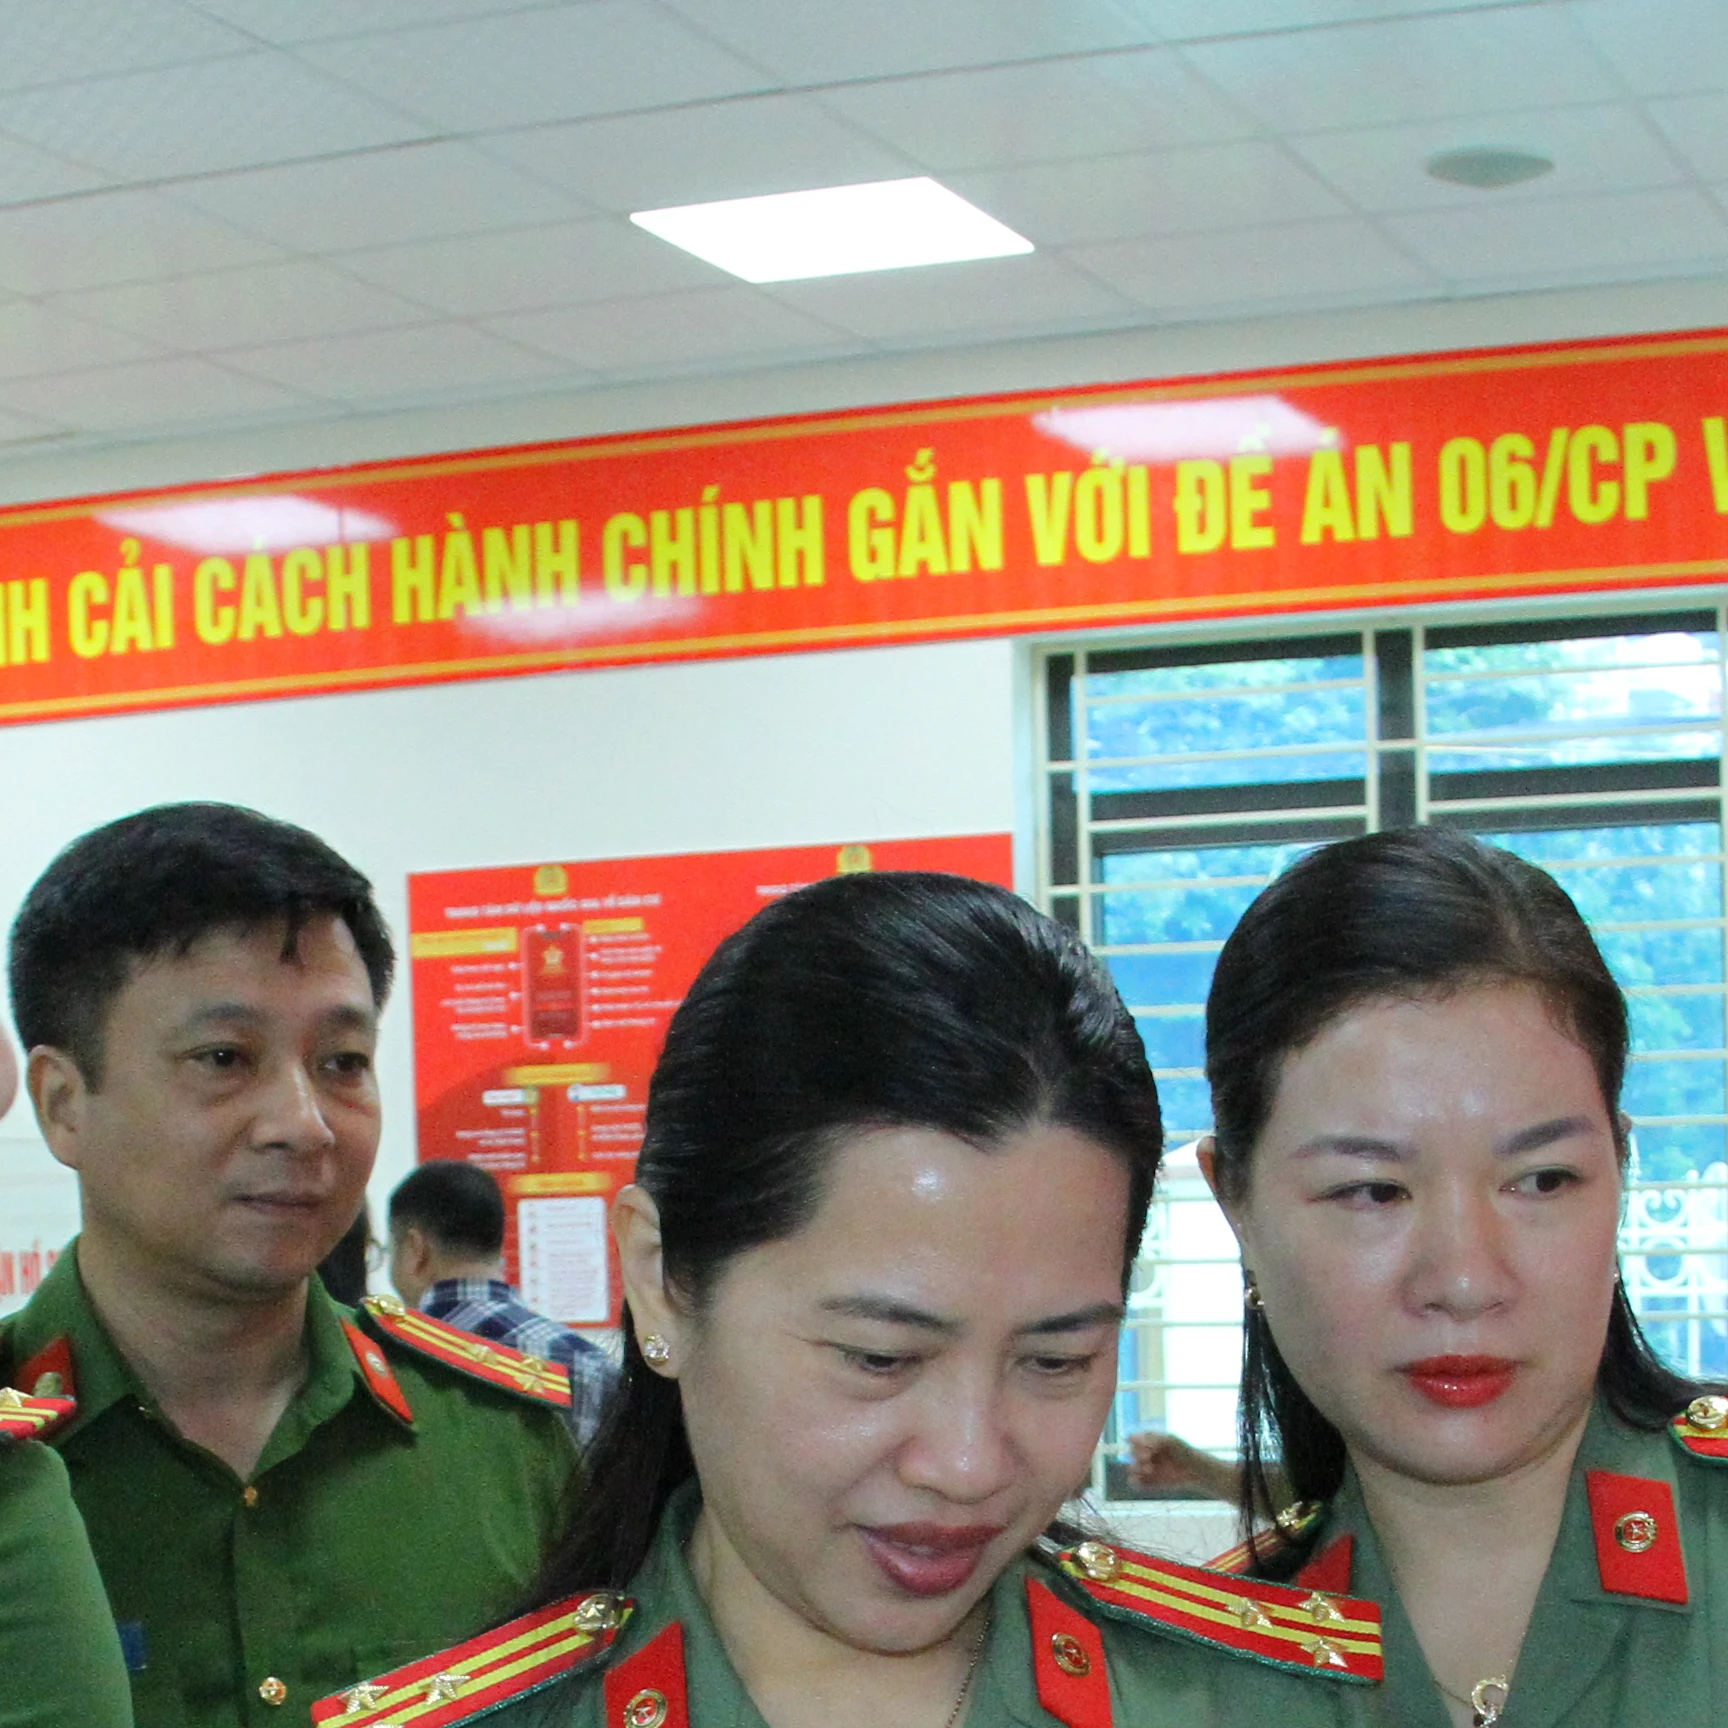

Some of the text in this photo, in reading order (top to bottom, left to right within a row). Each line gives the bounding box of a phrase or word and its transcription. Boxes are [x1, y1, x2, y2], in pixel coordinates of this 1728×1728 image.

[67, 537, 176, 659] CẢI
[193, 534, 371, 645] CÁCH
[391, 511, 581, 625] HÀNH
[602, 484, 826, 602] CHÍNH
[847, 448, 1005, 583] GẮN
[1024, 448, 1153, 566] VỚI
[1300, 426, 1414, 545] ÁN
[1439, 422, 1677, 534] 06/CP
